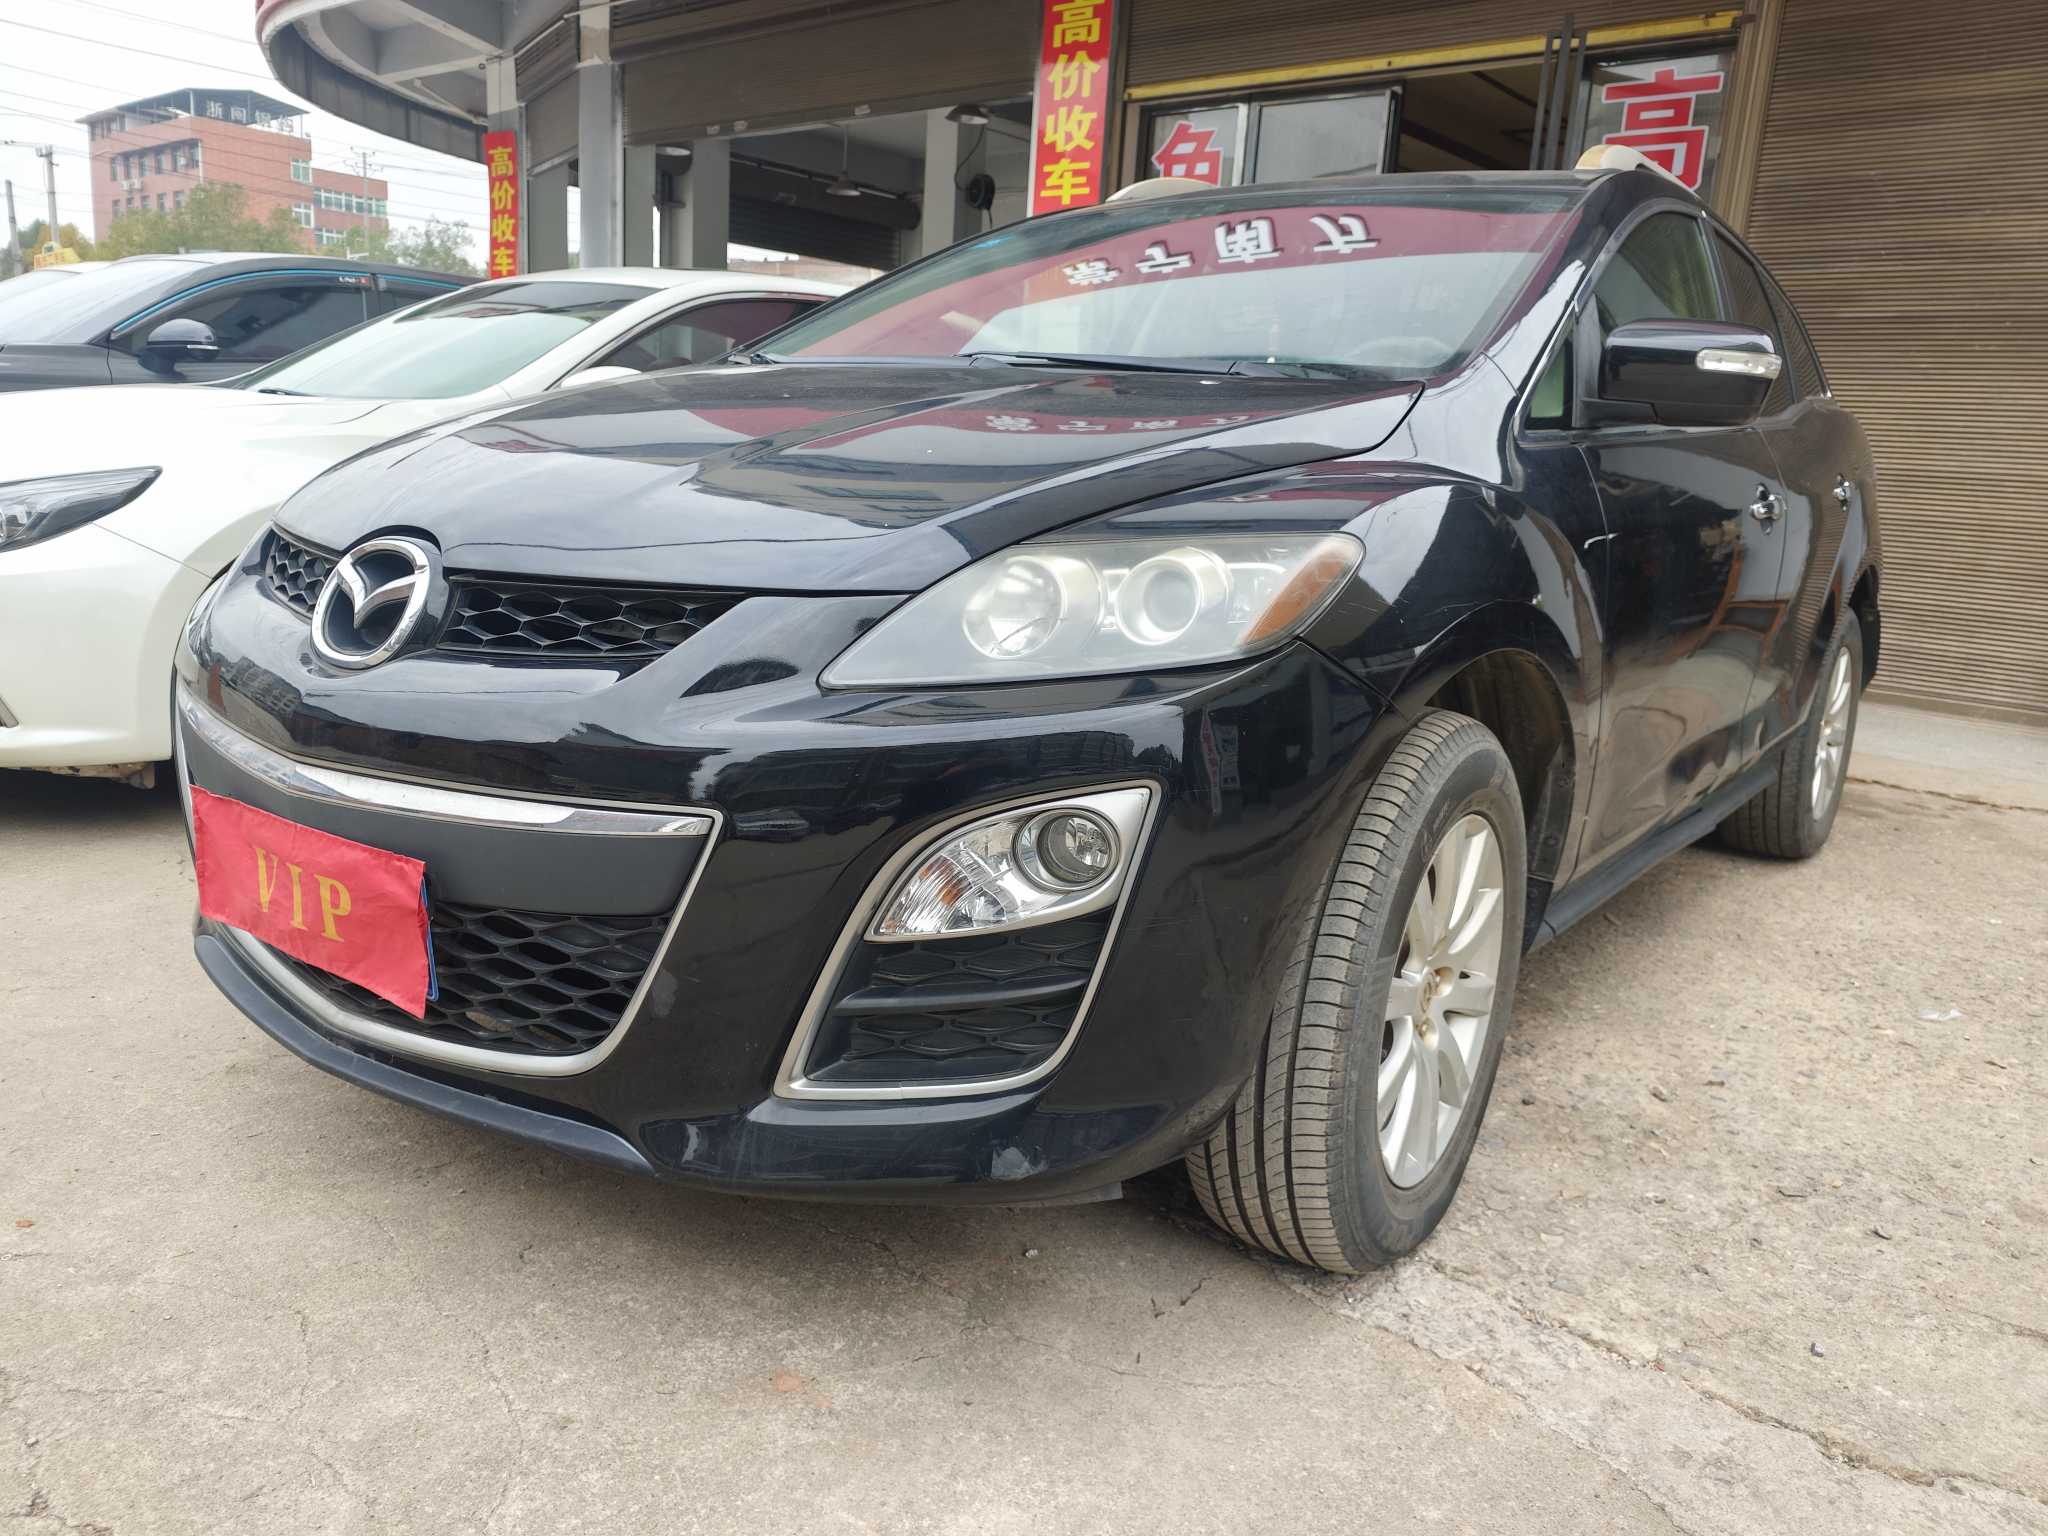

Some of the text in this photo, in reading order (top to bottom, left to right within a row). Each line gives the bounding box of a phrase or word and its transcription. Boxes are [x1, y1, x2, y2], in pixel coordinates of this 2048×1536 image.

[1040, 0, 1102, 205] 高价收车
[1602, 67, 1725, 190] 高
[487, 147, 516, 277] 高价收车
[254, 847, 352, 942] VIP
